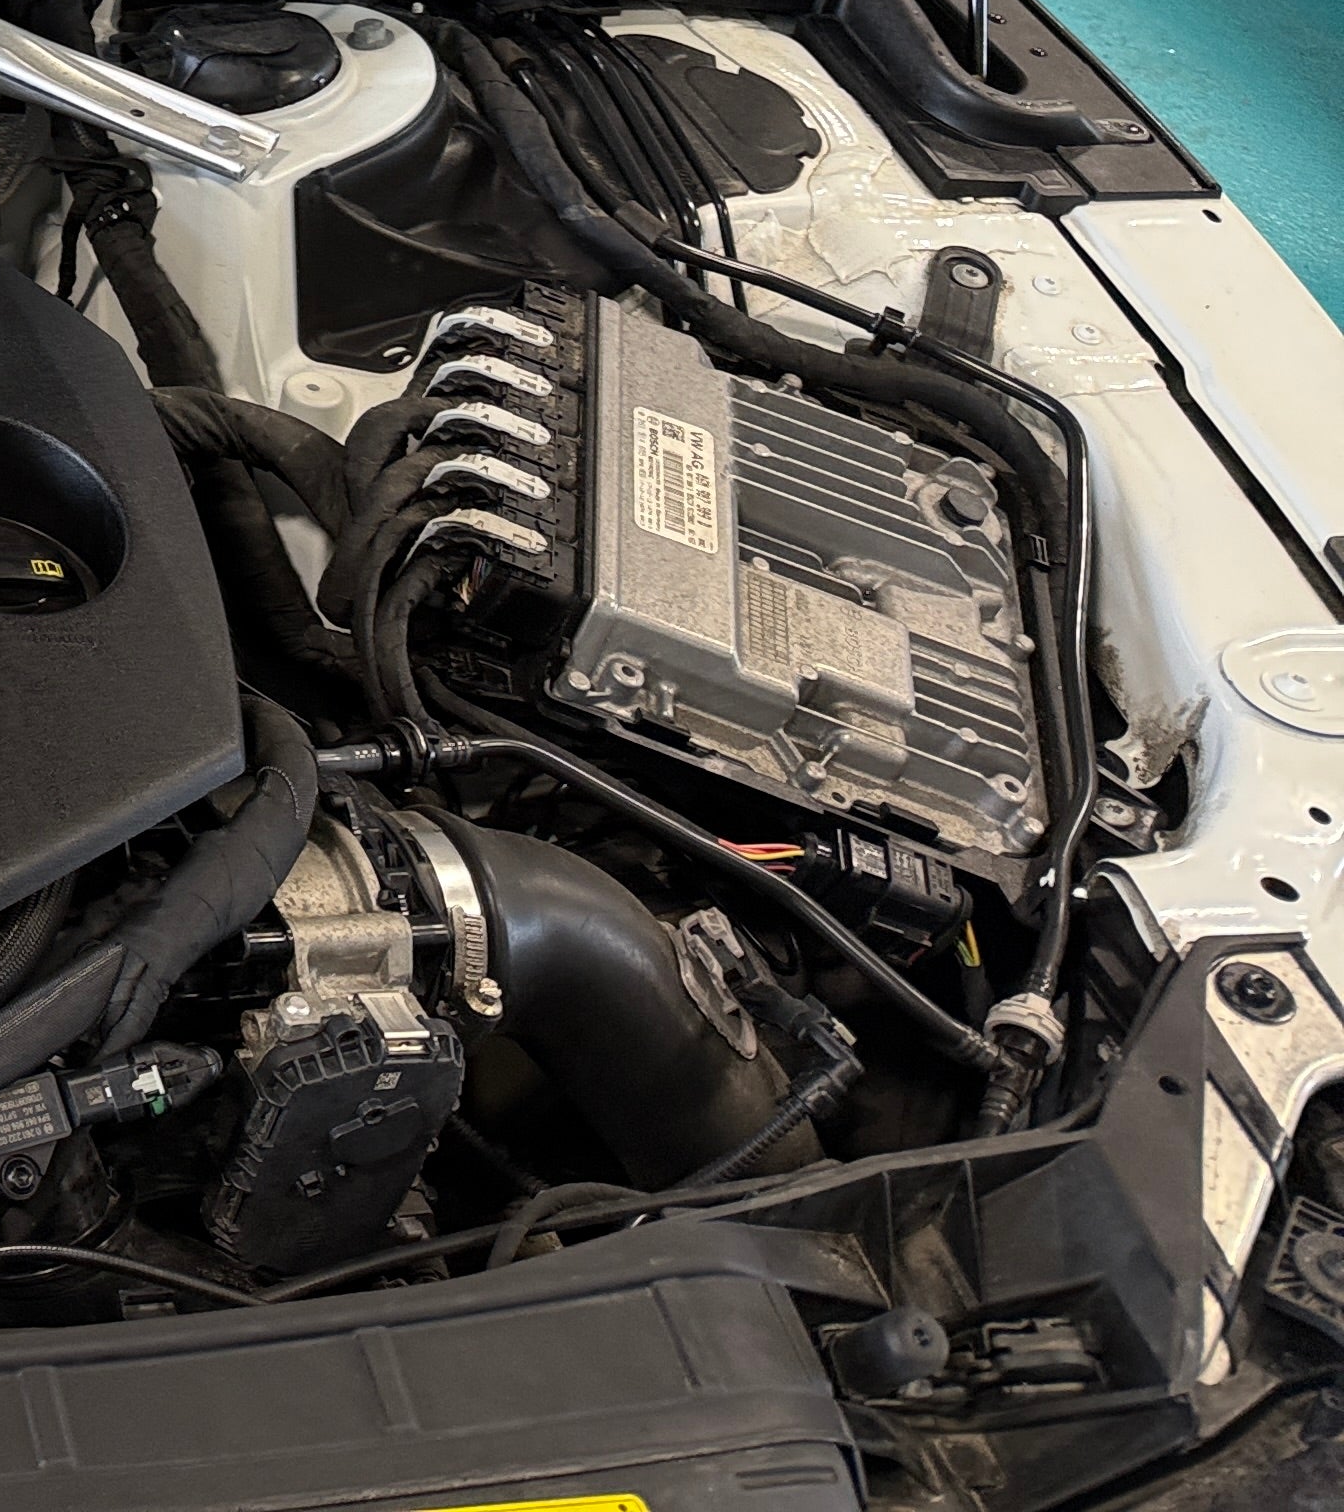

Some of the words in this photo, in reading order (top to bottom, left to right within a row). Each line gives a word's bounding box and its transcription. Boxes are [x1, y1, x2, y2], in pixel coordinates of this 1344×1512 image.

[648, 427, 660, 457] BOSCH
[690, 430, 704, 452] VW
[691, 451, 705, 470] AG
